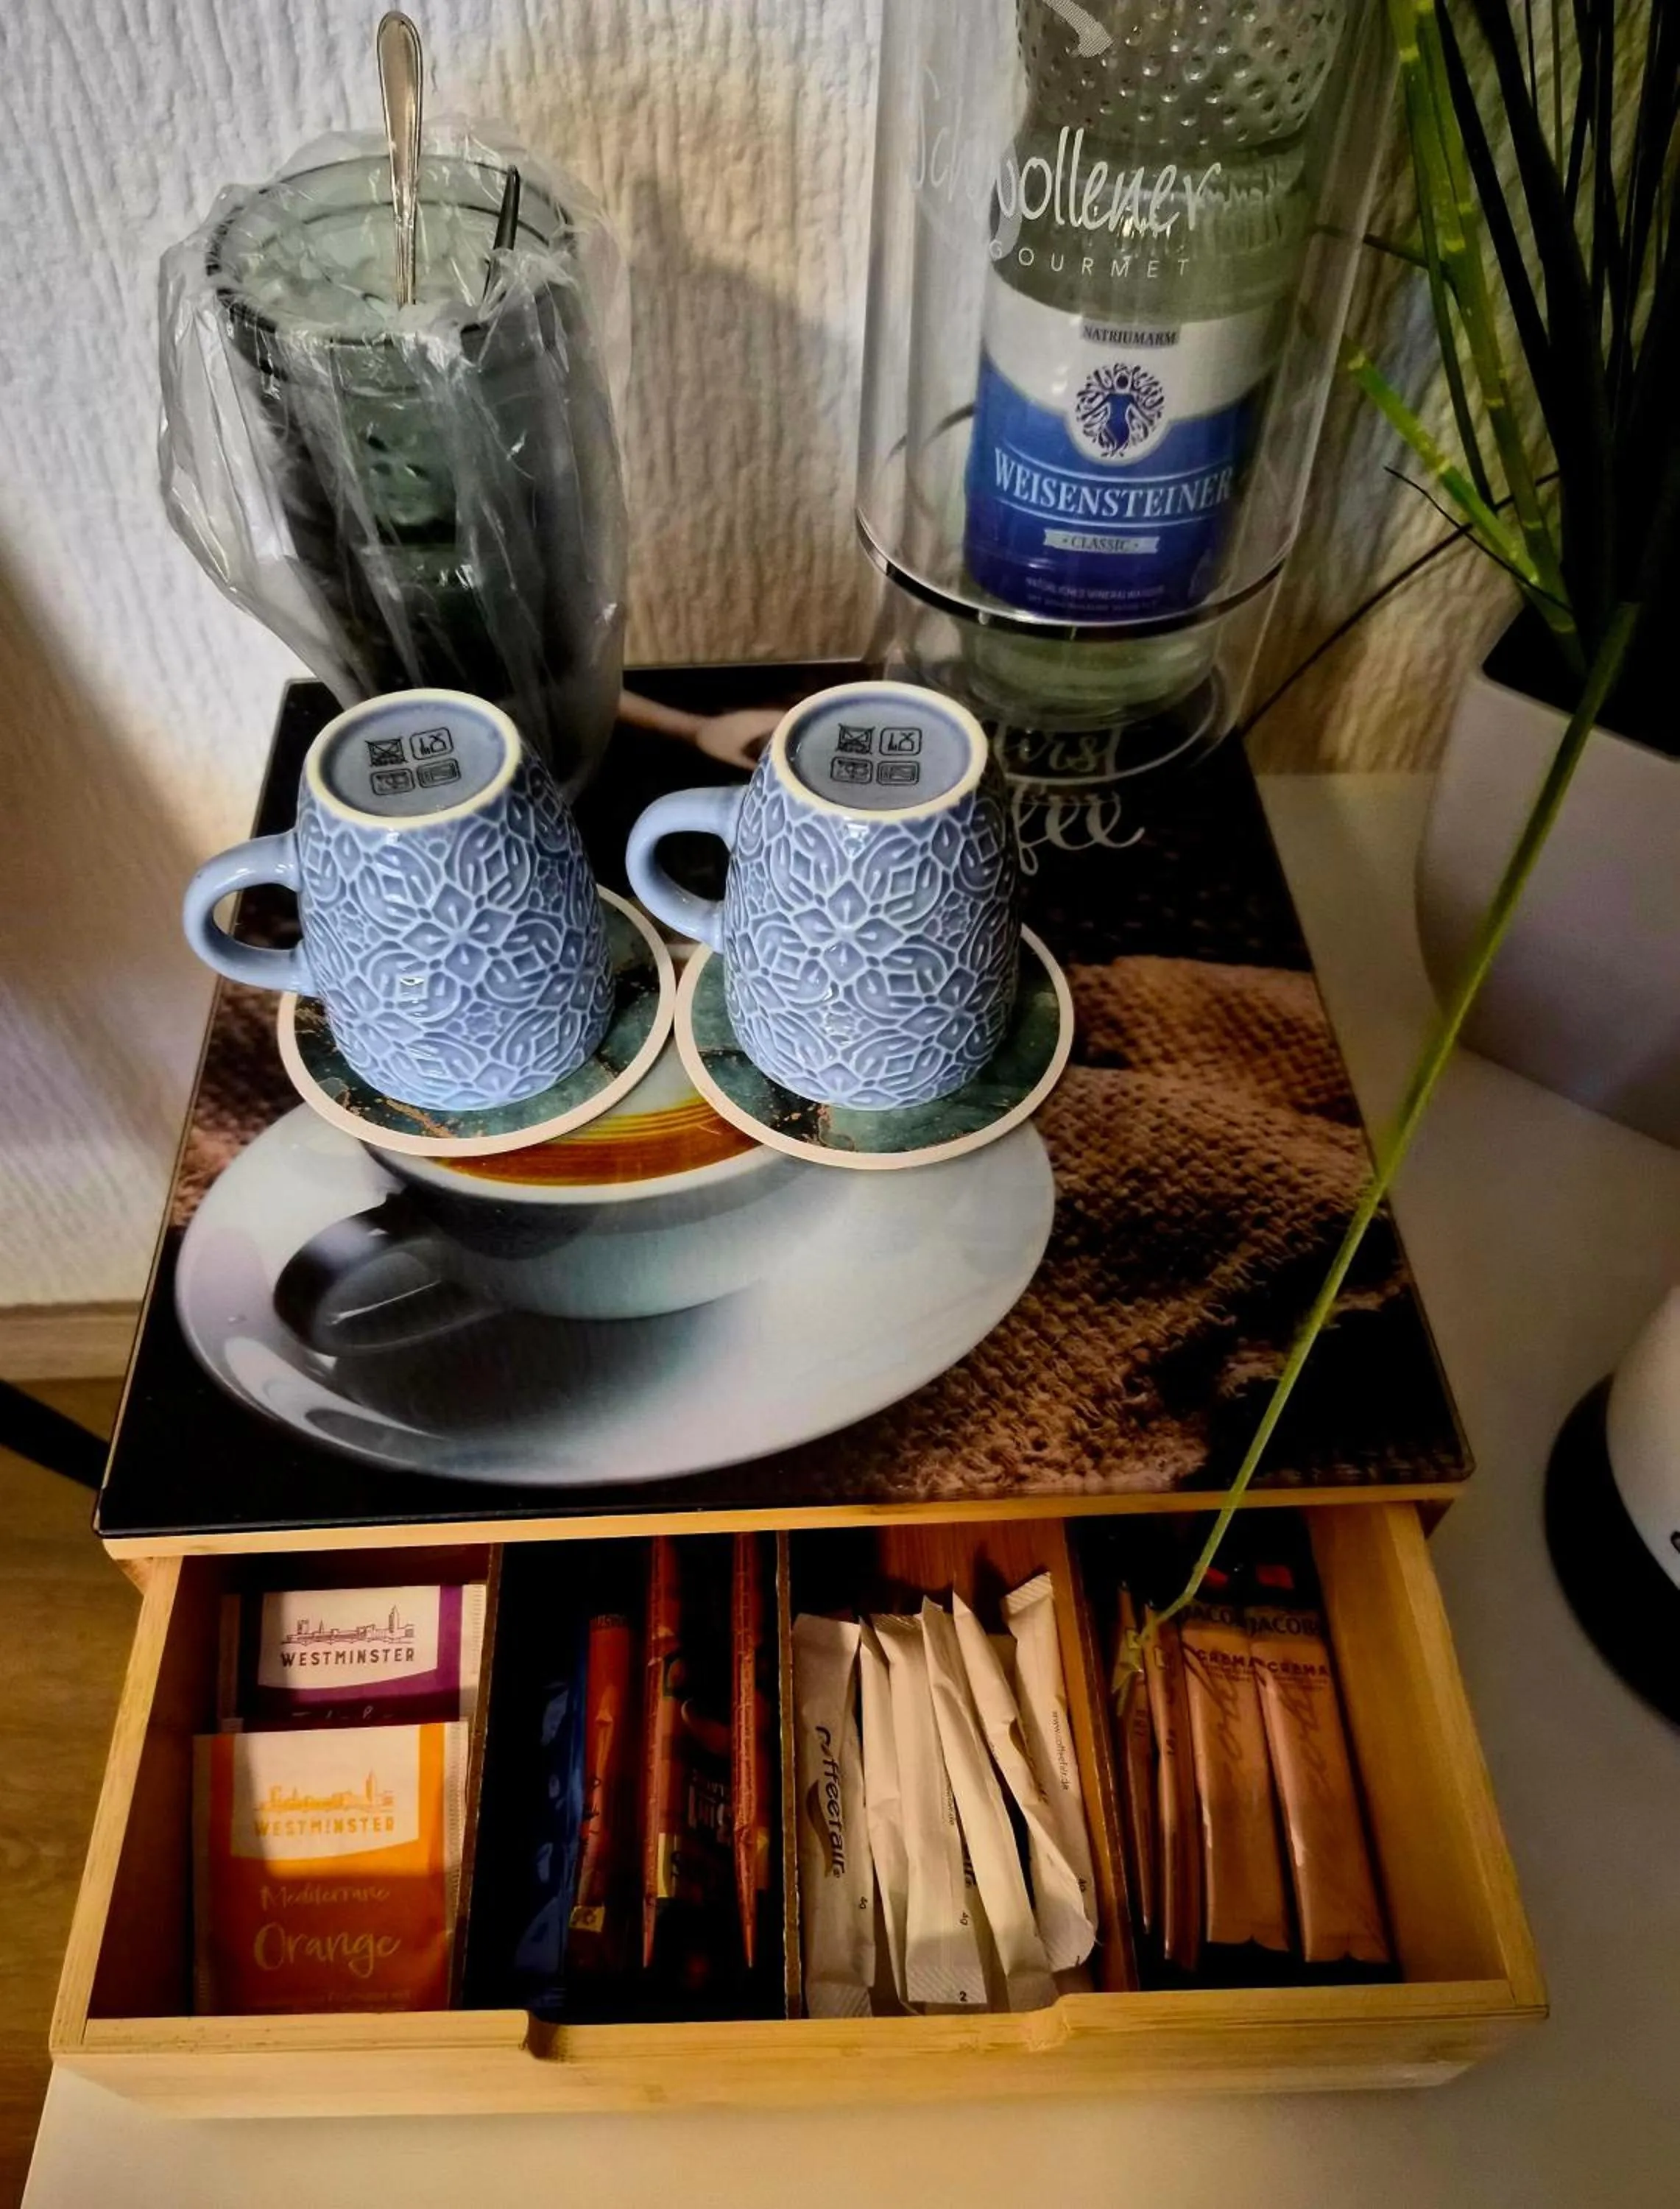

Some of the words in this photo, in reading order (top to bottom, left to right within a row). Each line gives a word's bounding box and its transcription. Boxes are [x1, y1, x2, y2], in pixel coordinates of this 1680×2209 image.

[989, 240, 1191, 279] GOURMET
[1083, 324, 1178, 348] NATRIUMARM
[994, 446, 1235, 518] WEISENSTEINER
[1070, 536, 1131, 553] CLASSIC
[280, 1646, 415, 1668] WESTMINSTER
[253, 1815, 395, 1838] WESTMINSTER
[253, 1920, 403, 1979] Orange
[959, 1990, 967, 2002] 2
